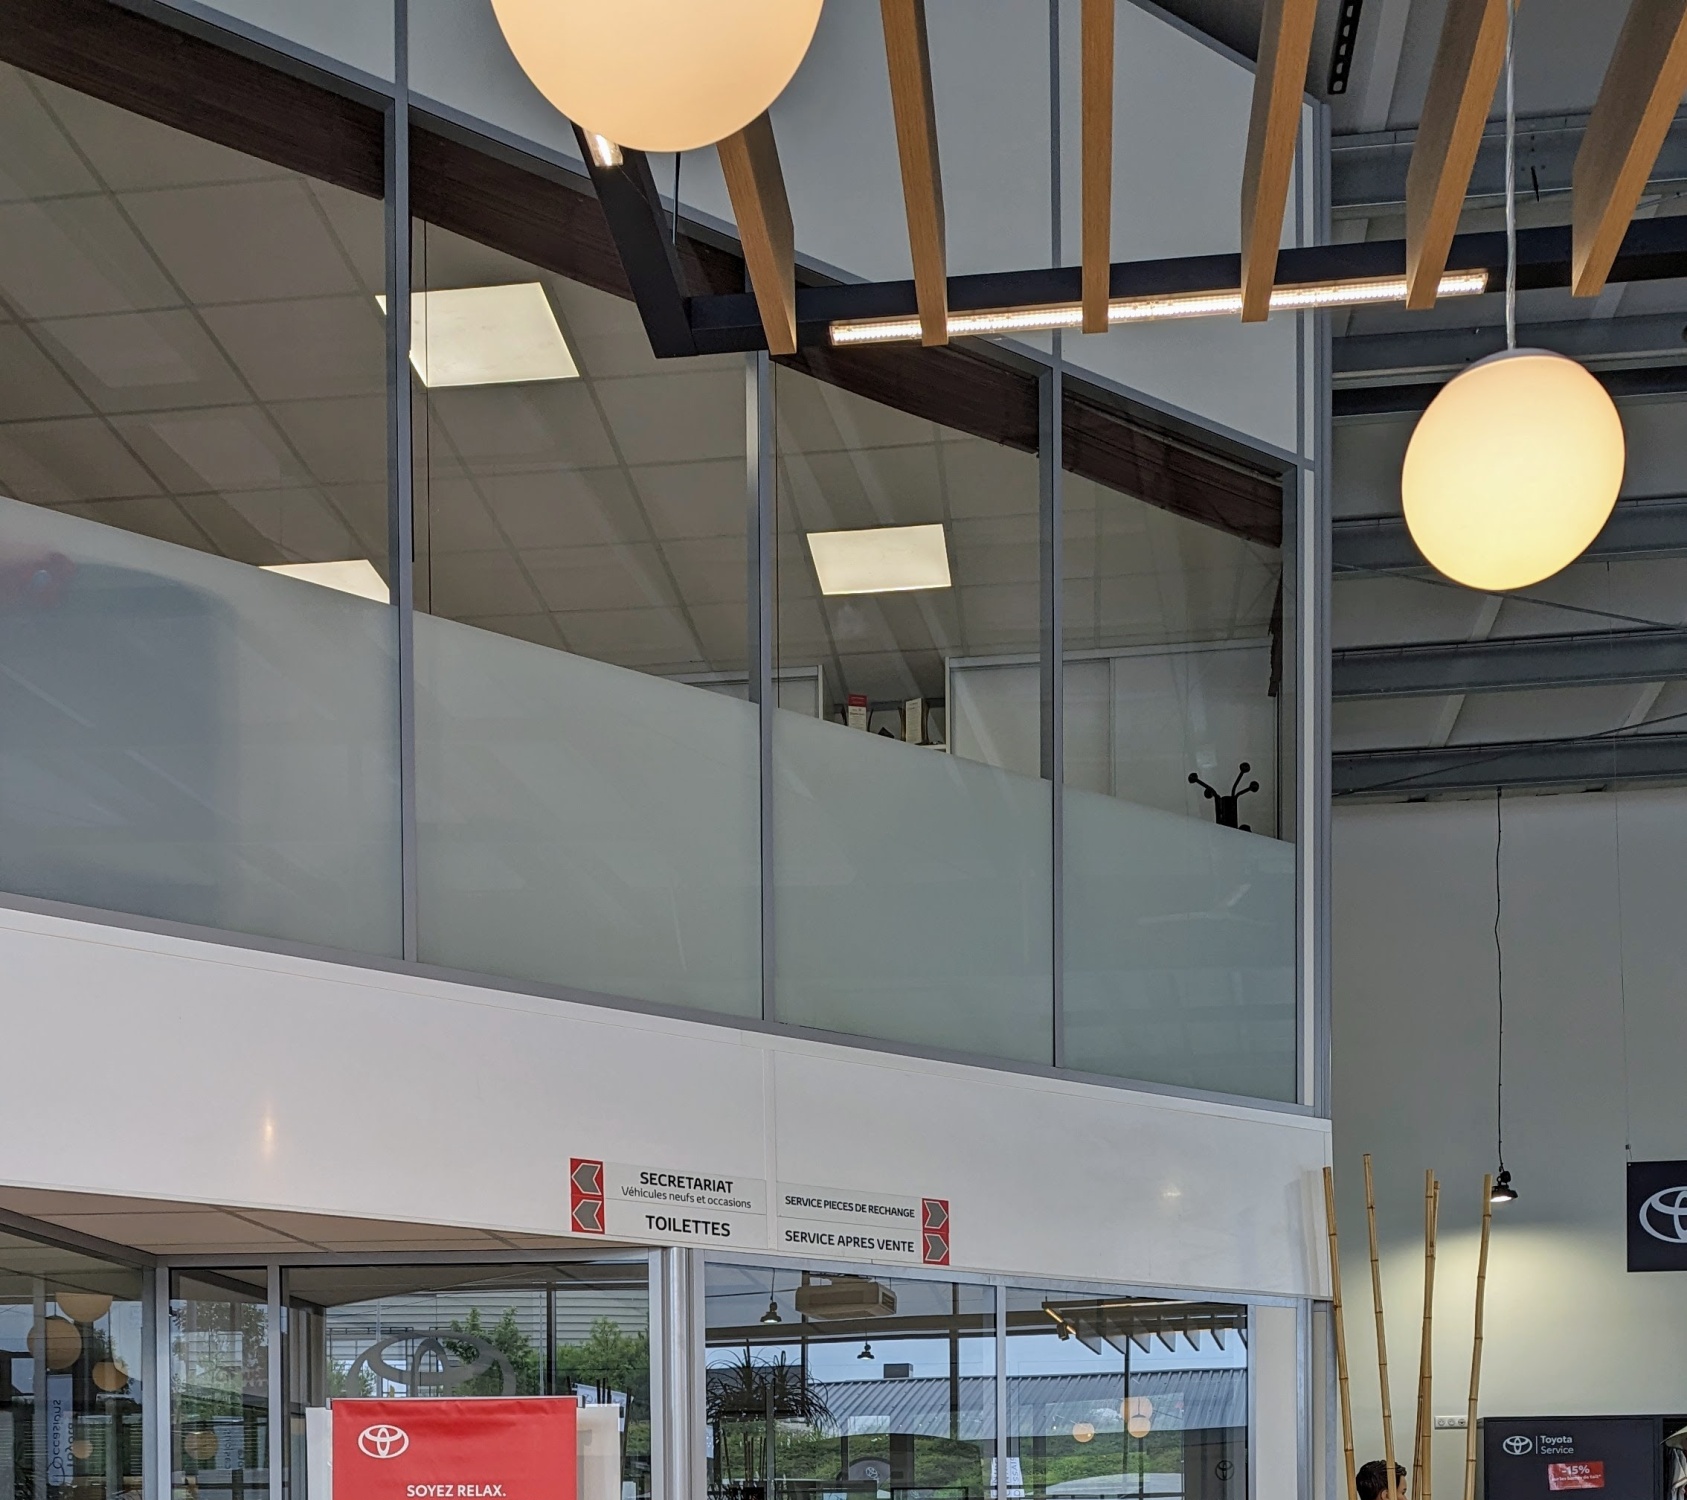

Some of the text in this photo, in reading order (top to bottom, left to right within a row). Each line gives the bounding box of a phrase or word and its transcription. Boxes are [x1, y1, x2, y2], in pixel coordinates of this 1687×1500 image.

[640, 1171, 734, 1194] SECRETARIAT
[621, 1185, 752, 1209] Véhicules neufs et occasions
[785, 1195, 916, 1219] SERVICE PIECES DE RECHANGE
[645, 1214, 731, 1238] TOILETTES
[784, 1229, 915, 1253] SERVICE APRES VENTE
[1540, 1435, 1573, 1446] Toyota
[1540, 1445, 1575, 1455] Service
[1561, 1464, 1591, 1475] -15%
[406, 1484, 507, 1498] SOYEZ RELAX.
